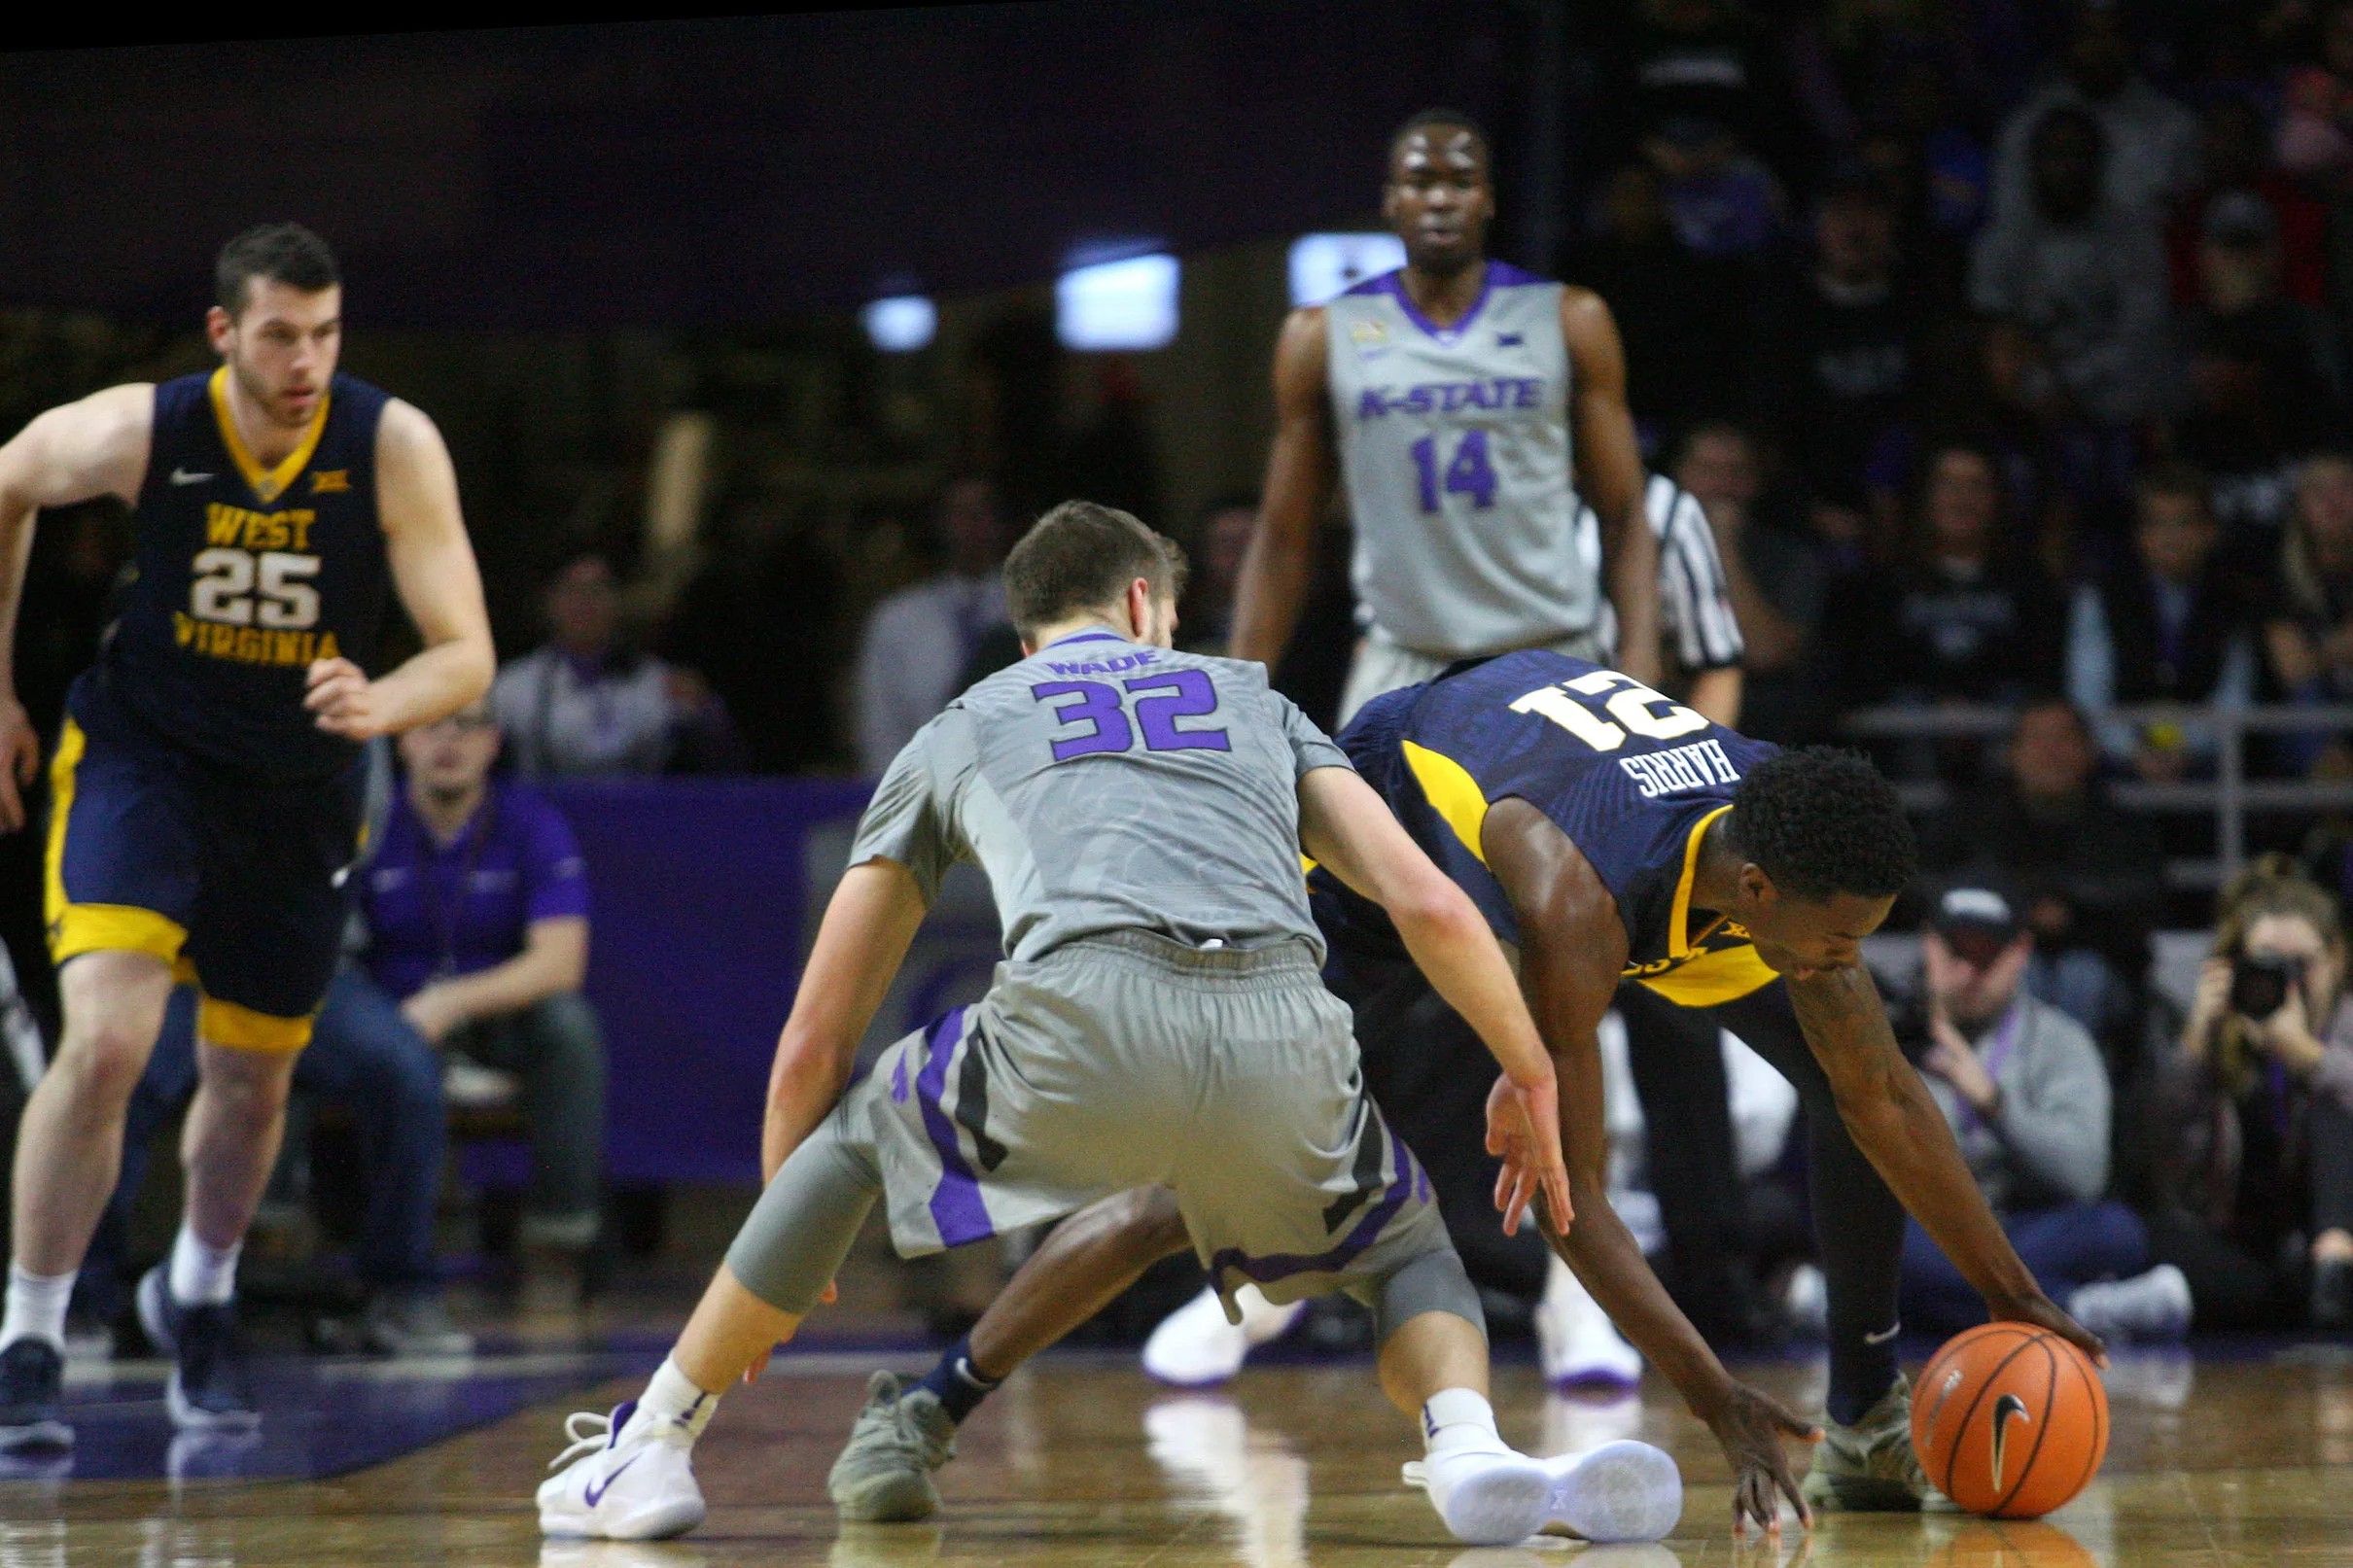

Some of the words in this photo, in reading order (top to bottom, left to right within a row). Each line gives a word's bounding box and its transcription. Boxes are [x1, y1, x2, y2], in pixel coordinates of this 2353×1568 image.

[1357, 376, 1543, 420] K-STATE
[1414, 429, 1497, 512] 14
[206, 502, 317, 549] WEST
[191, 547, 322, 630] 25
[171, 610, 340, 667] VIRGINIA
[1046, 649, 1162, 675] WADE
[1030, 669, 1233, 762] 32
[1508, 670, 1711, 752] 21
[1619, 739, 1741, 798] HARRIS
